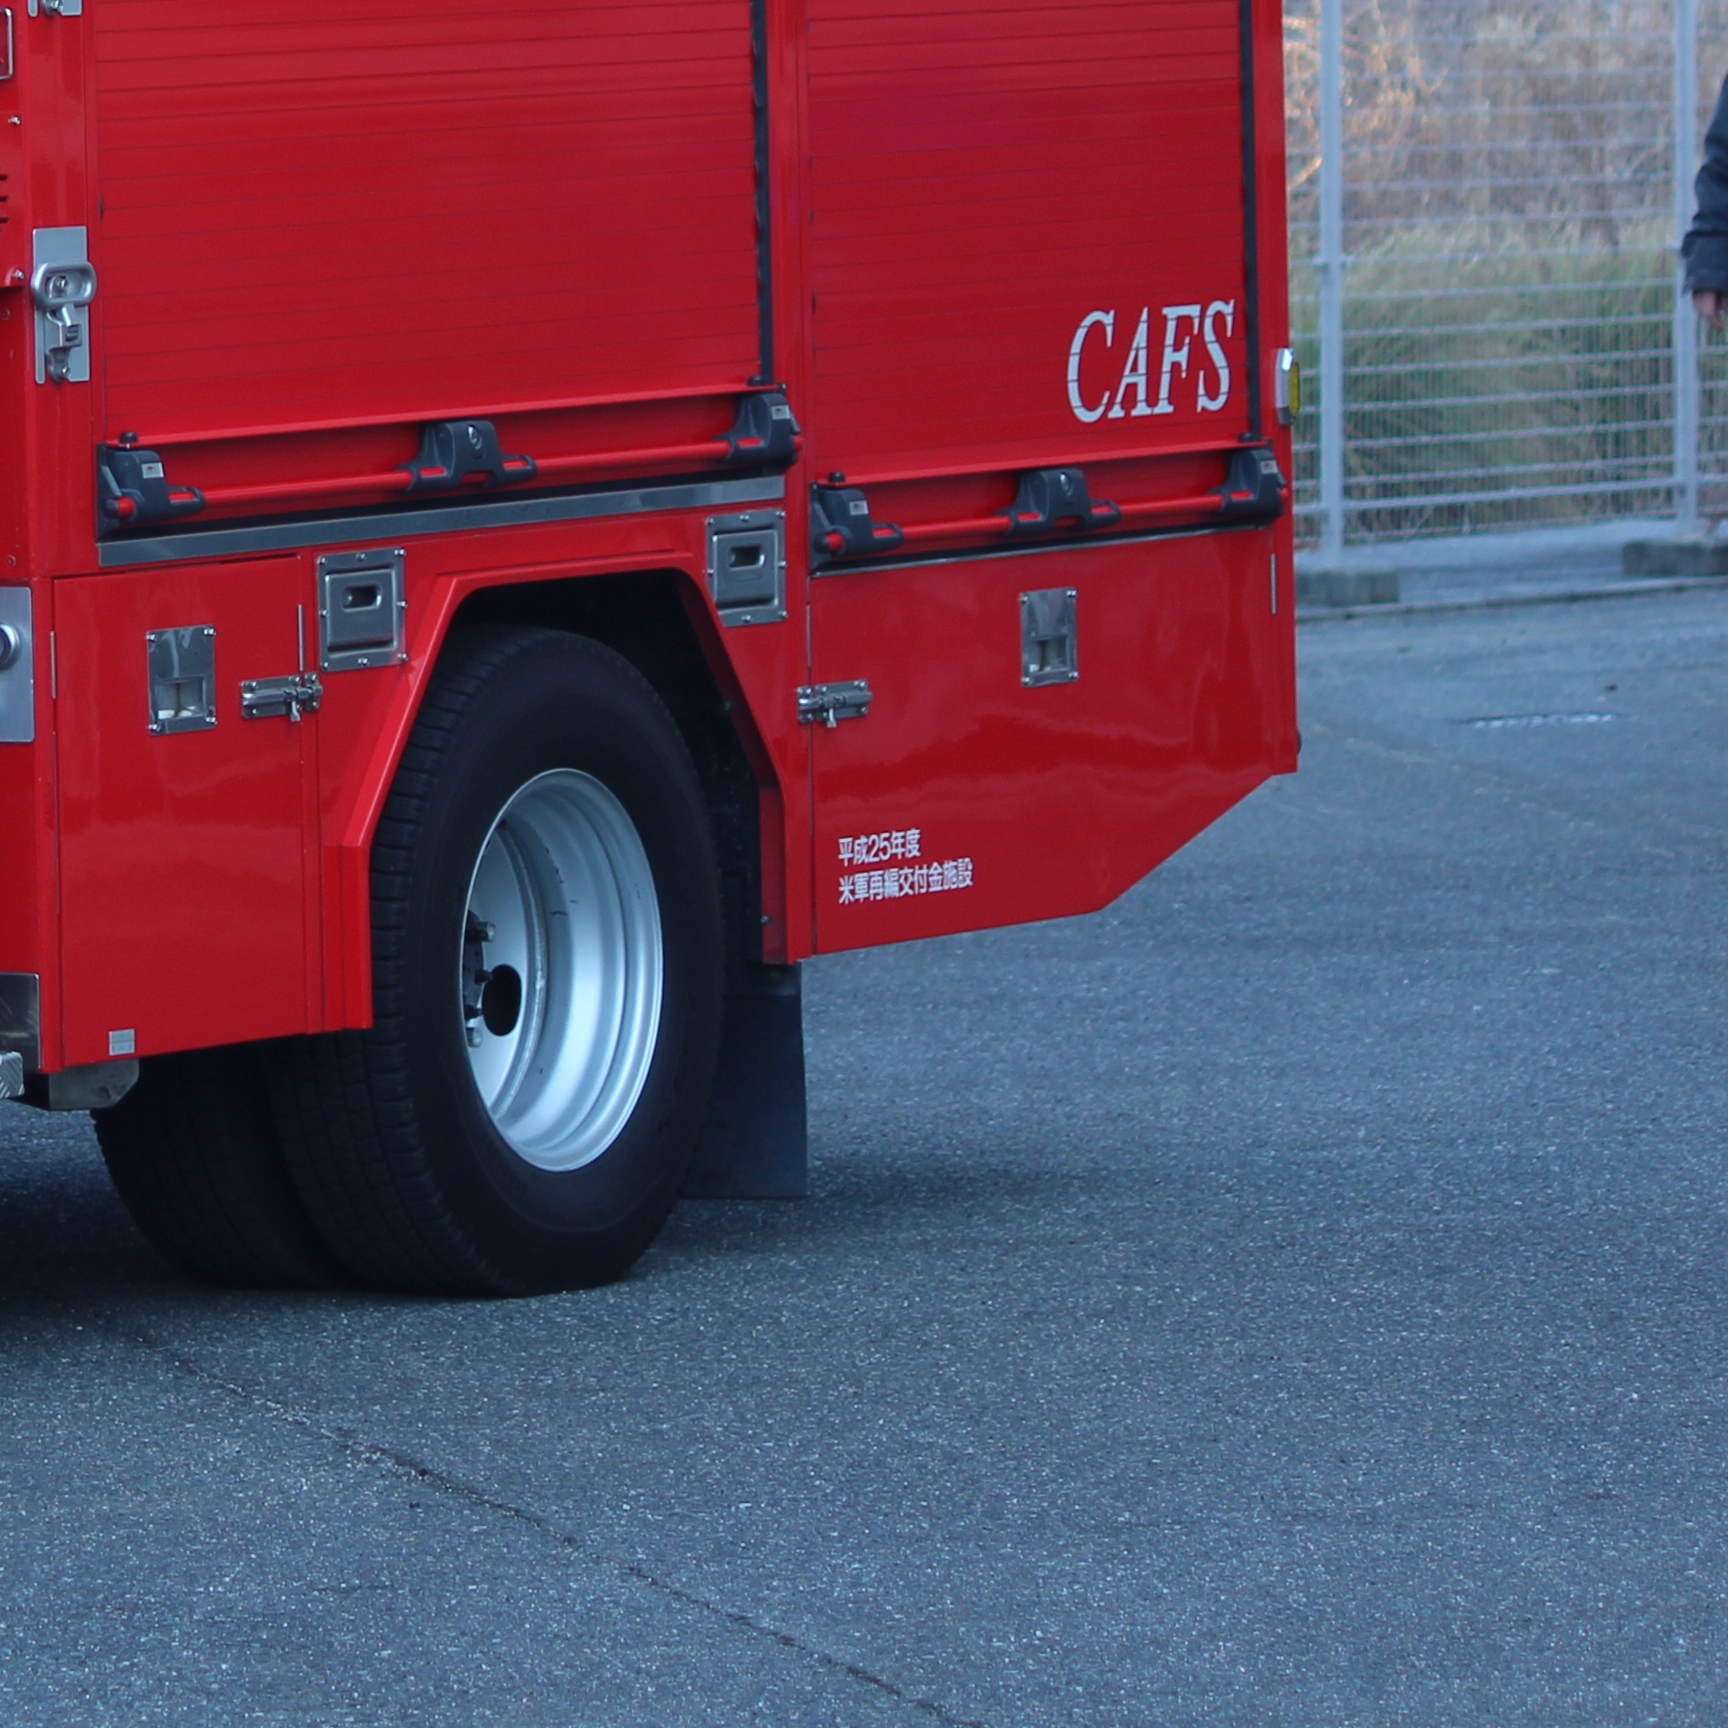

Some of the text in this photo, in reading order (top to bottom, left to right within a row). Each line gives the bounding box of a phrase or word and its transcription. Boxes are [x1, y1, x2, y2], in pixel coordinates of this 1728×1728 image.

[1066, 300, 1235, 424] CAFS
[838, 828, 921, 867] 平成25年度
[839, 857, 973, 904] 米軍再編交付金施設
